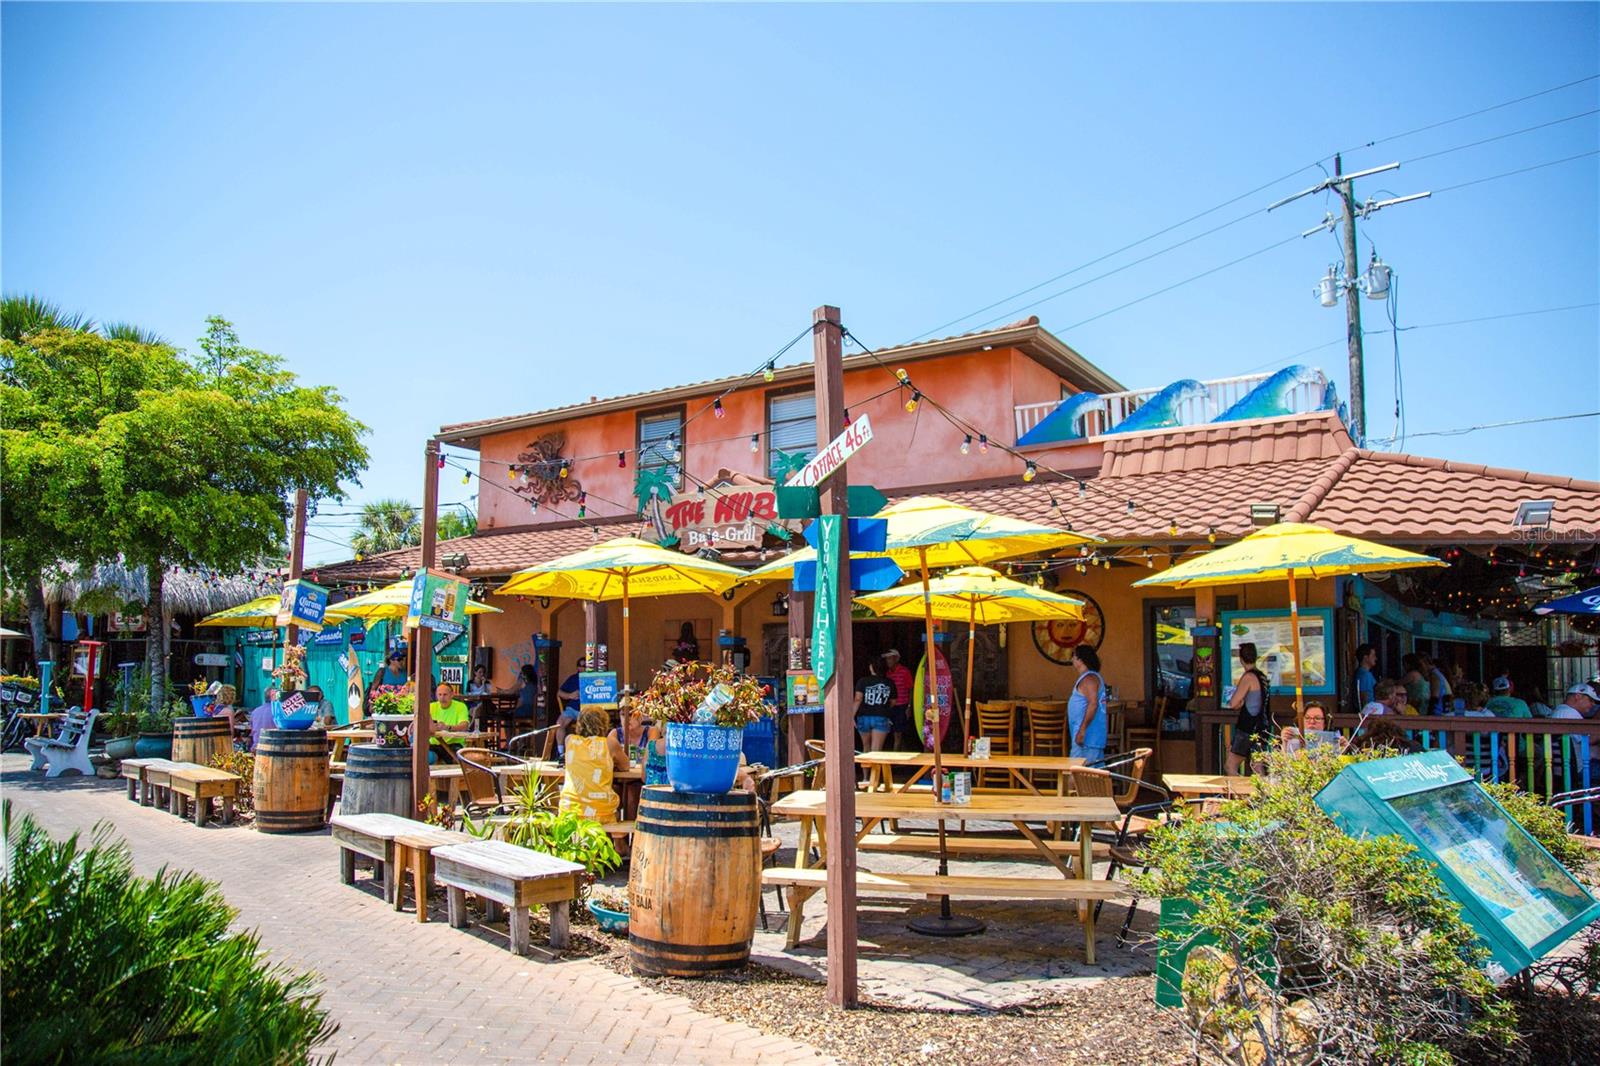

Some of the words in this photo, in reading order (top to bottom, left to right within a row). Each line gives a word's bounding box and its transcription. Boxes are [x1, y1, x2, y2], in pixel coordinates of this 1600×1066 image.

[845, 423, 863, 452] 46
[665, 499, 706, 530] THE
[713, 491, 778, 524] HUB
[822, 519, 834, 564] YOU
[820, 567, 829, 609] ARE
[816, 611, 830, 681] HERE
[441, 669, 462, 683] BAJA
[584, 684, 613, 695] Corona
